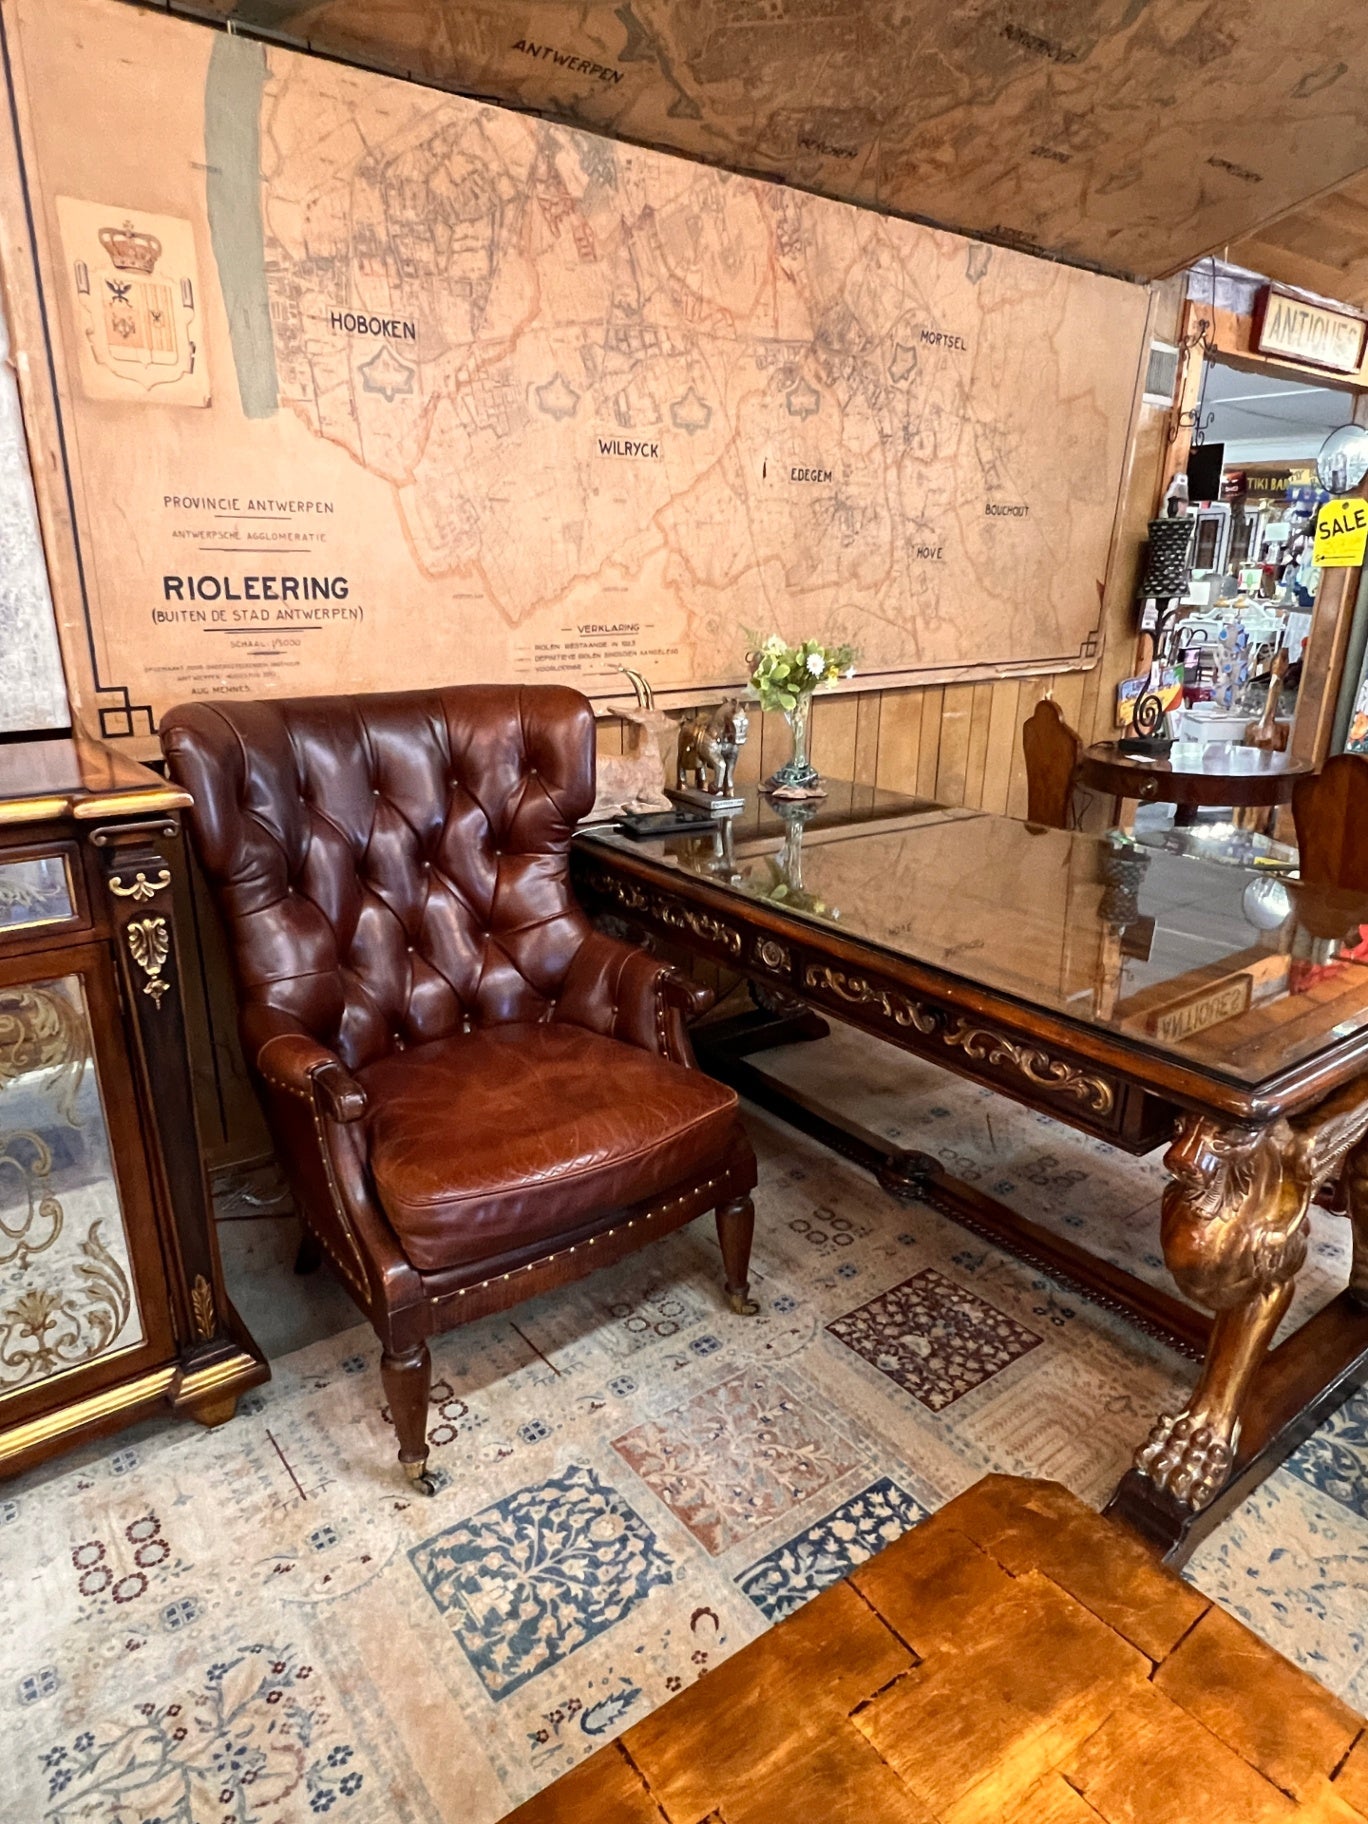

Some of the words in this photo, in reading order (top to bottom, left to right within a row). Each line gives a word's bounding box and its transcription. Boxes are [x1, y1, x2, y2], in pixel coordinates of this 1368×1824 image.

[511, 39, 624, 84] ANTWERPEN
[331, 311, 416, 341] HOBOKEN
[1269, 303, 1357, 361] ANTIQUES
[920, 329, 967, 352] MORTSEL
[598, 439, 659, 460] WILRYCK
[790, 467, 832, 483] EDEGEM
[1248, 477, 1268, 490] TIKI
[163, 495, 241, 511] PROVINCIE
[247, 499, 334, 514] ANTWERPEN
[984, 504, 1029, 517] BOUCHOUT
[1319, 508, 1367, 540] SALE
[247, 531, 327, 543] AGGLOMERATIE
[916, 547, 943, 560] HOVE
[162, 575, 349, 601] RIOLEERING
[151, 609, 207, 625] (BUITEN
[211, 610, 227, 622] DE
[233, 609, 270, 622] STAD
[276, 605, 364, 621] ANTWERPEN)
[577, 624, 640, 634] VERKLARING
